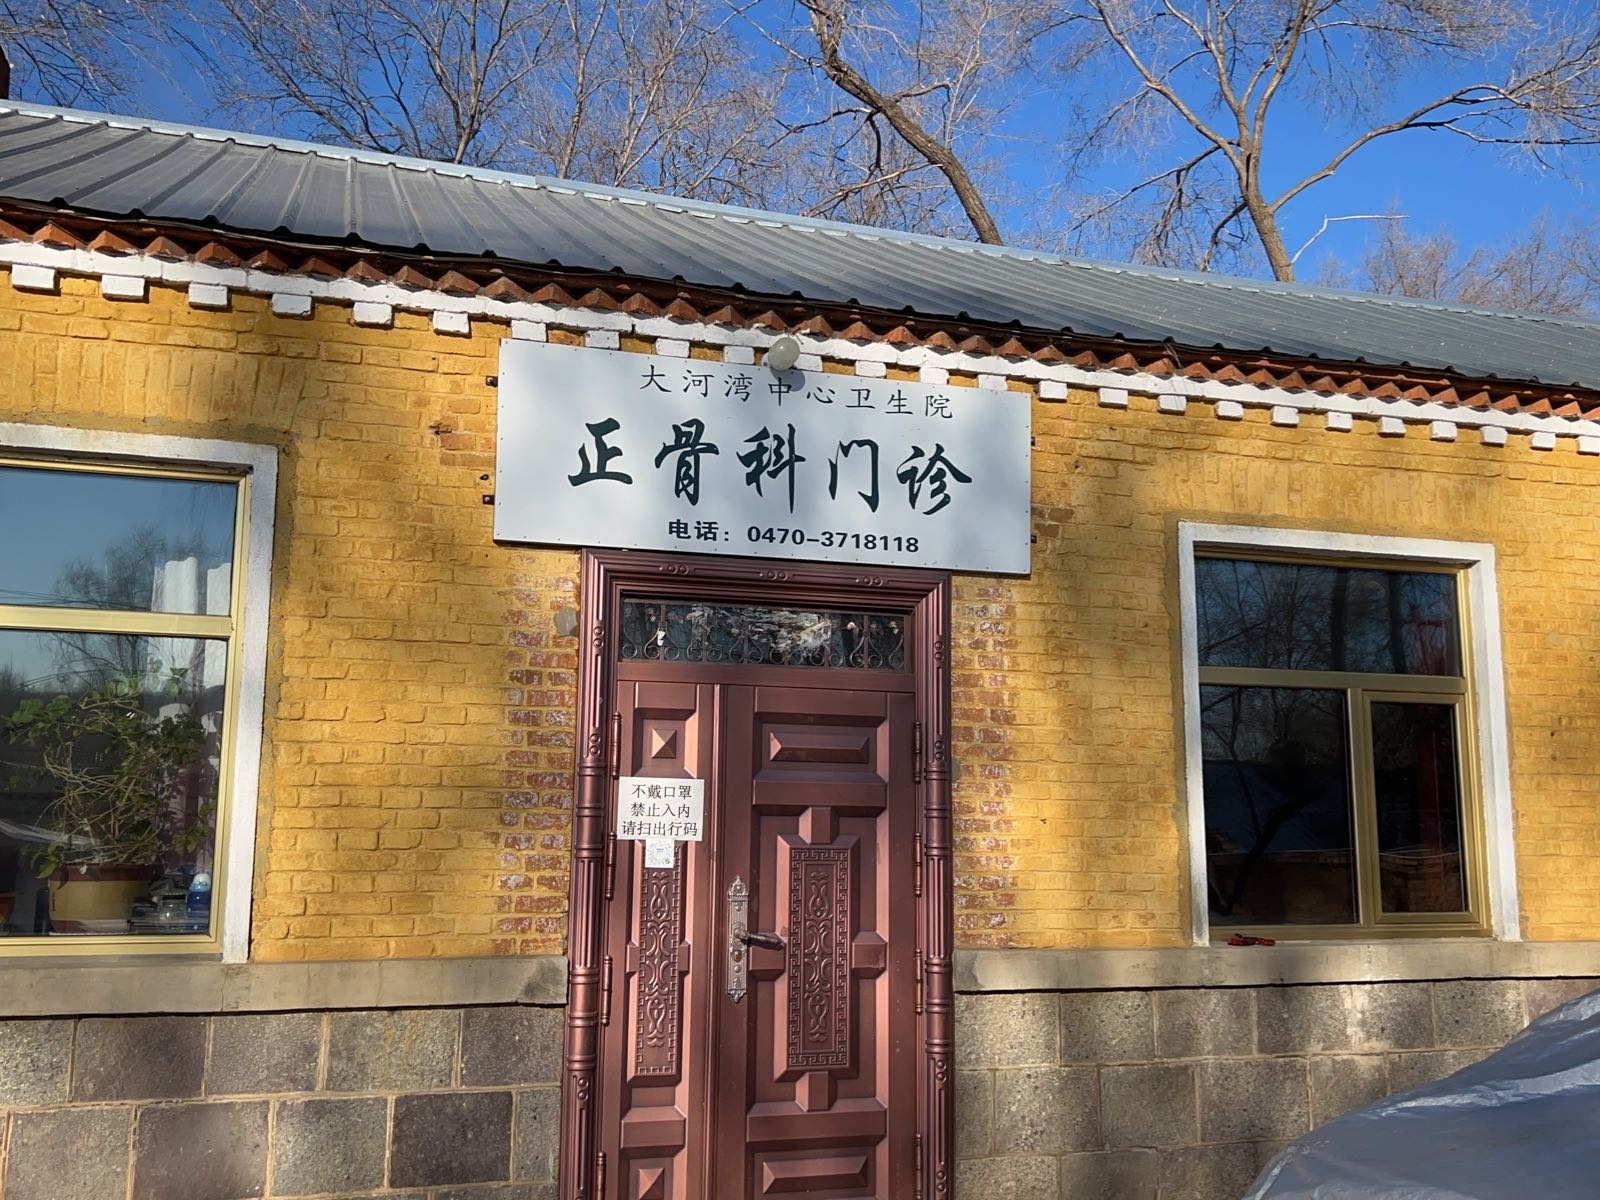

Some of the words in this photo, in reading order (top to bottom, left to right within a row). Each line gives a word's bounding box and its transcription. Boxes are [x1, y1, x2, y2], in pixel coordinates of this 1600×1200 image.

[640, 364, 953, 419] 大河湾中心卫生院
[567, 417, 973, 516] 正骨科门诊
[631, 784, 692, 800] 不戴口罩
[630, 802, 691, 818] 禁止入内
[622, 820, 698, 837] 请扫出行码
